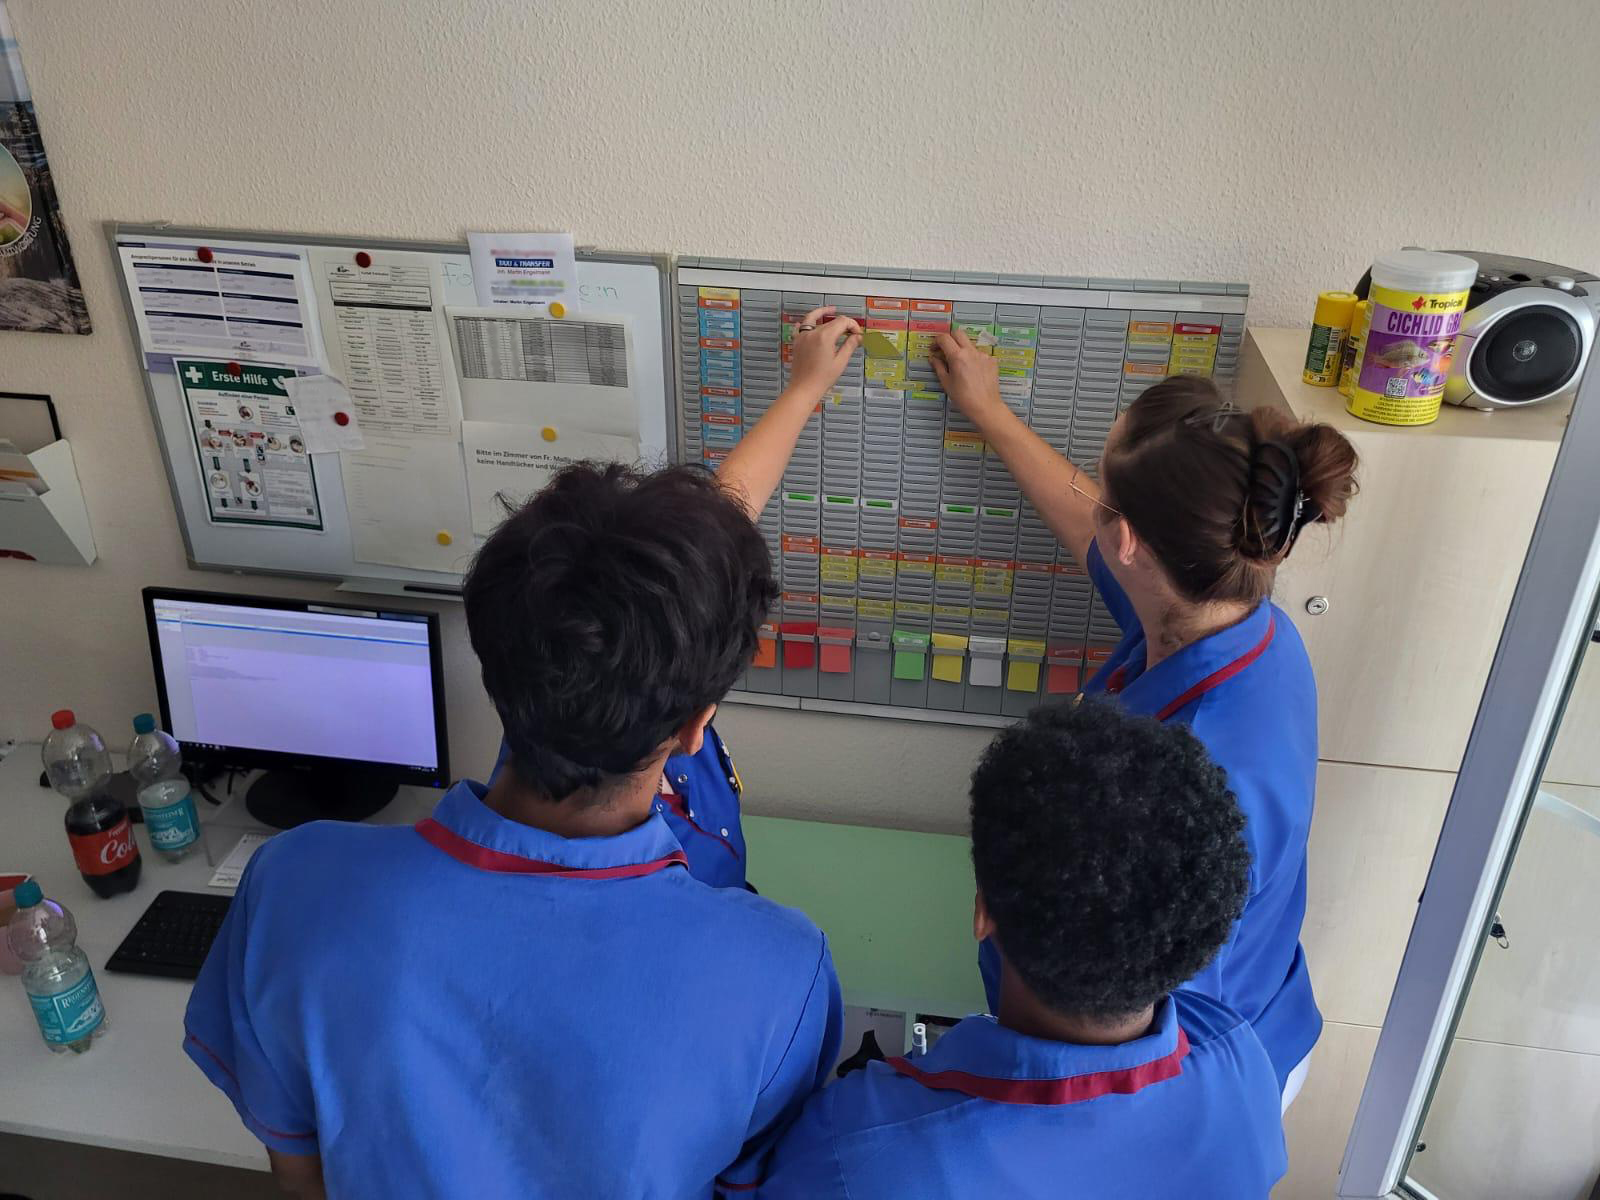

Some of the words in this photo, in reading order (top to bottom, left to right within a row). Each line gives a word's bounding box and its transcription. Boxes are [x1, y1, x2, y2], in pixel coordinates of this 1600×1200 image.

[1429, 297, 1464, 310] Tropical
[1387, 311, 1444, 336] CICHLID
[212, 371, 241, 383] Erste
[242, 373, 269, 386] Hilfe
[503, 450, 528, 459] Zimmer
